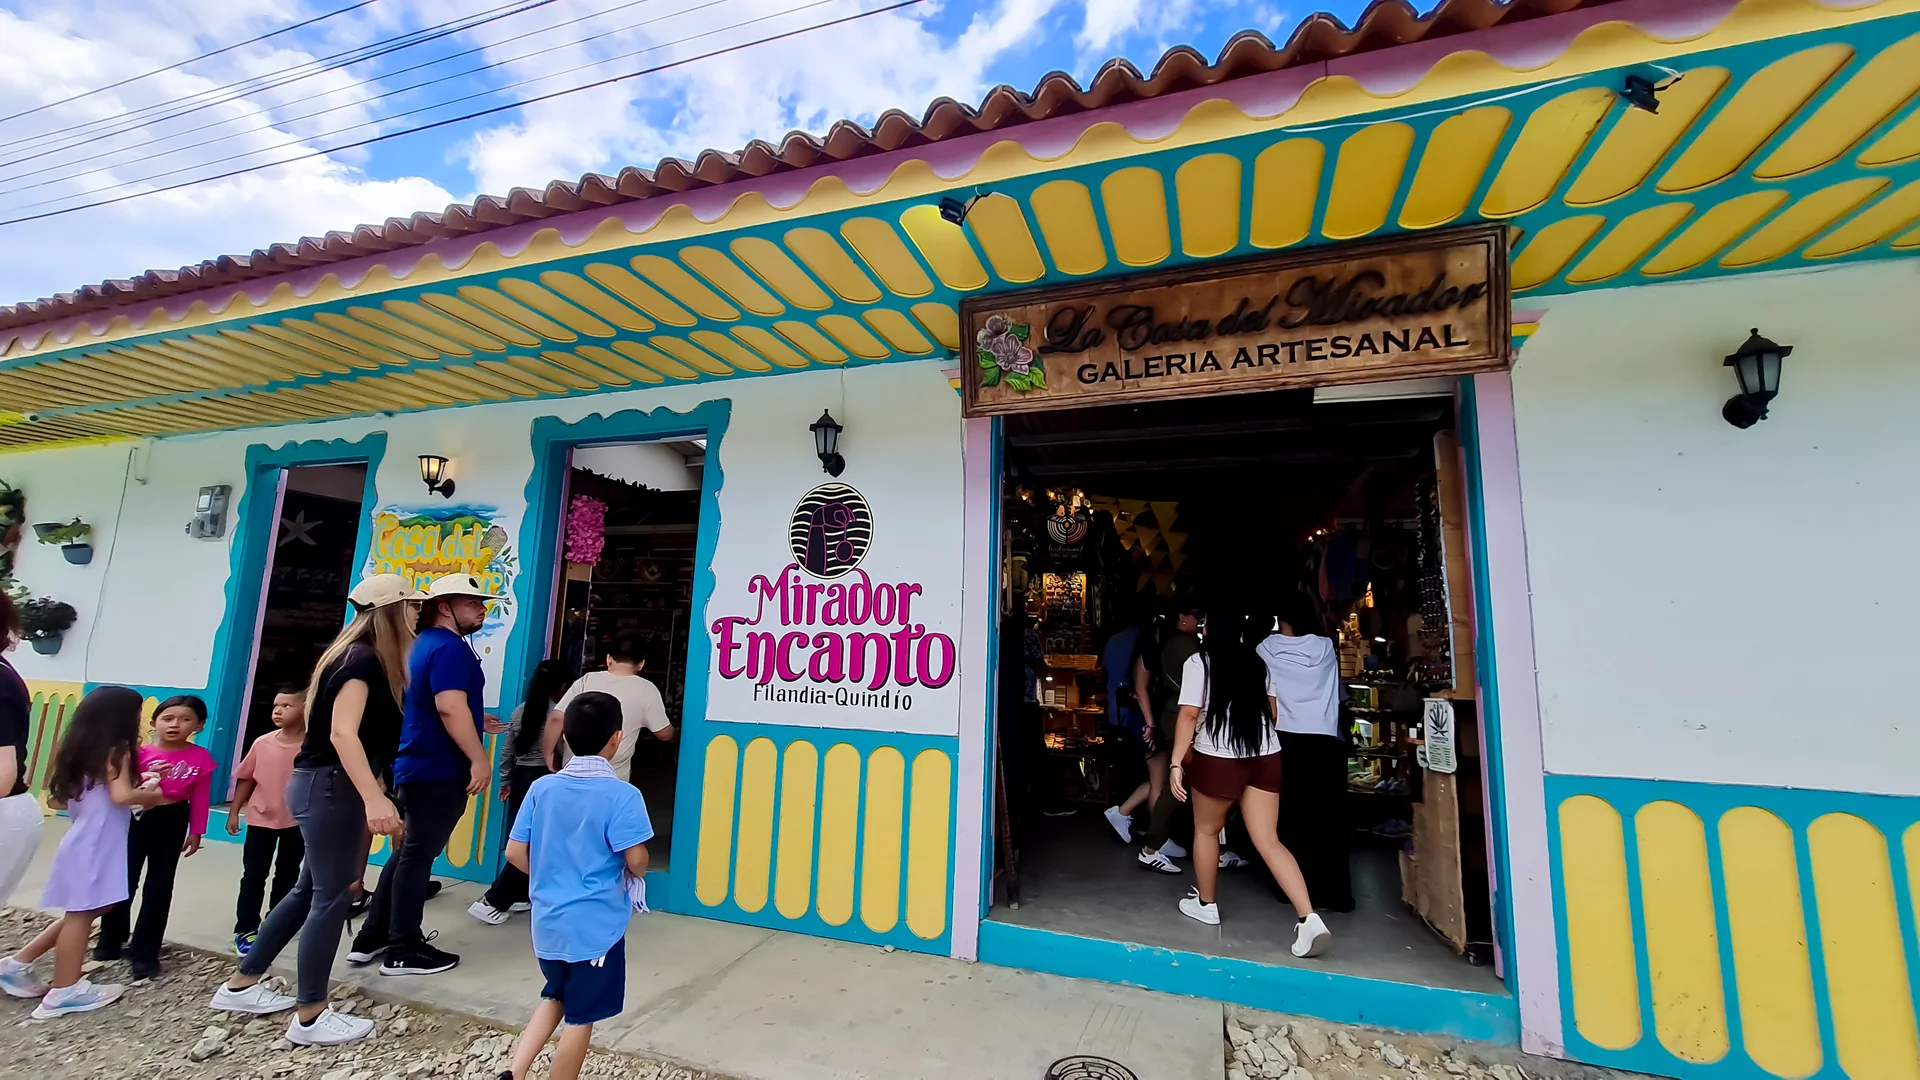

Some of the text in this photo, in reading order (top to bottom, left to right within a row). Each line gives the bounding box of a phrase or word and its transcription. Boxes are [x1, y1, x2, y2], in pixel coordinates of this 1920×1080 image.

[1038, 270, 1487, 354] La Casa del Mirador
[1077, 324, 1469, 384] GALERIA ARTESANAL
[372, 513, 486, 562] Casa del
[747, 563, 923, 626] Mirador
[711, 616, 956, 690] Encanto
[753, 684, 913, 711] Filandia-Quindío
